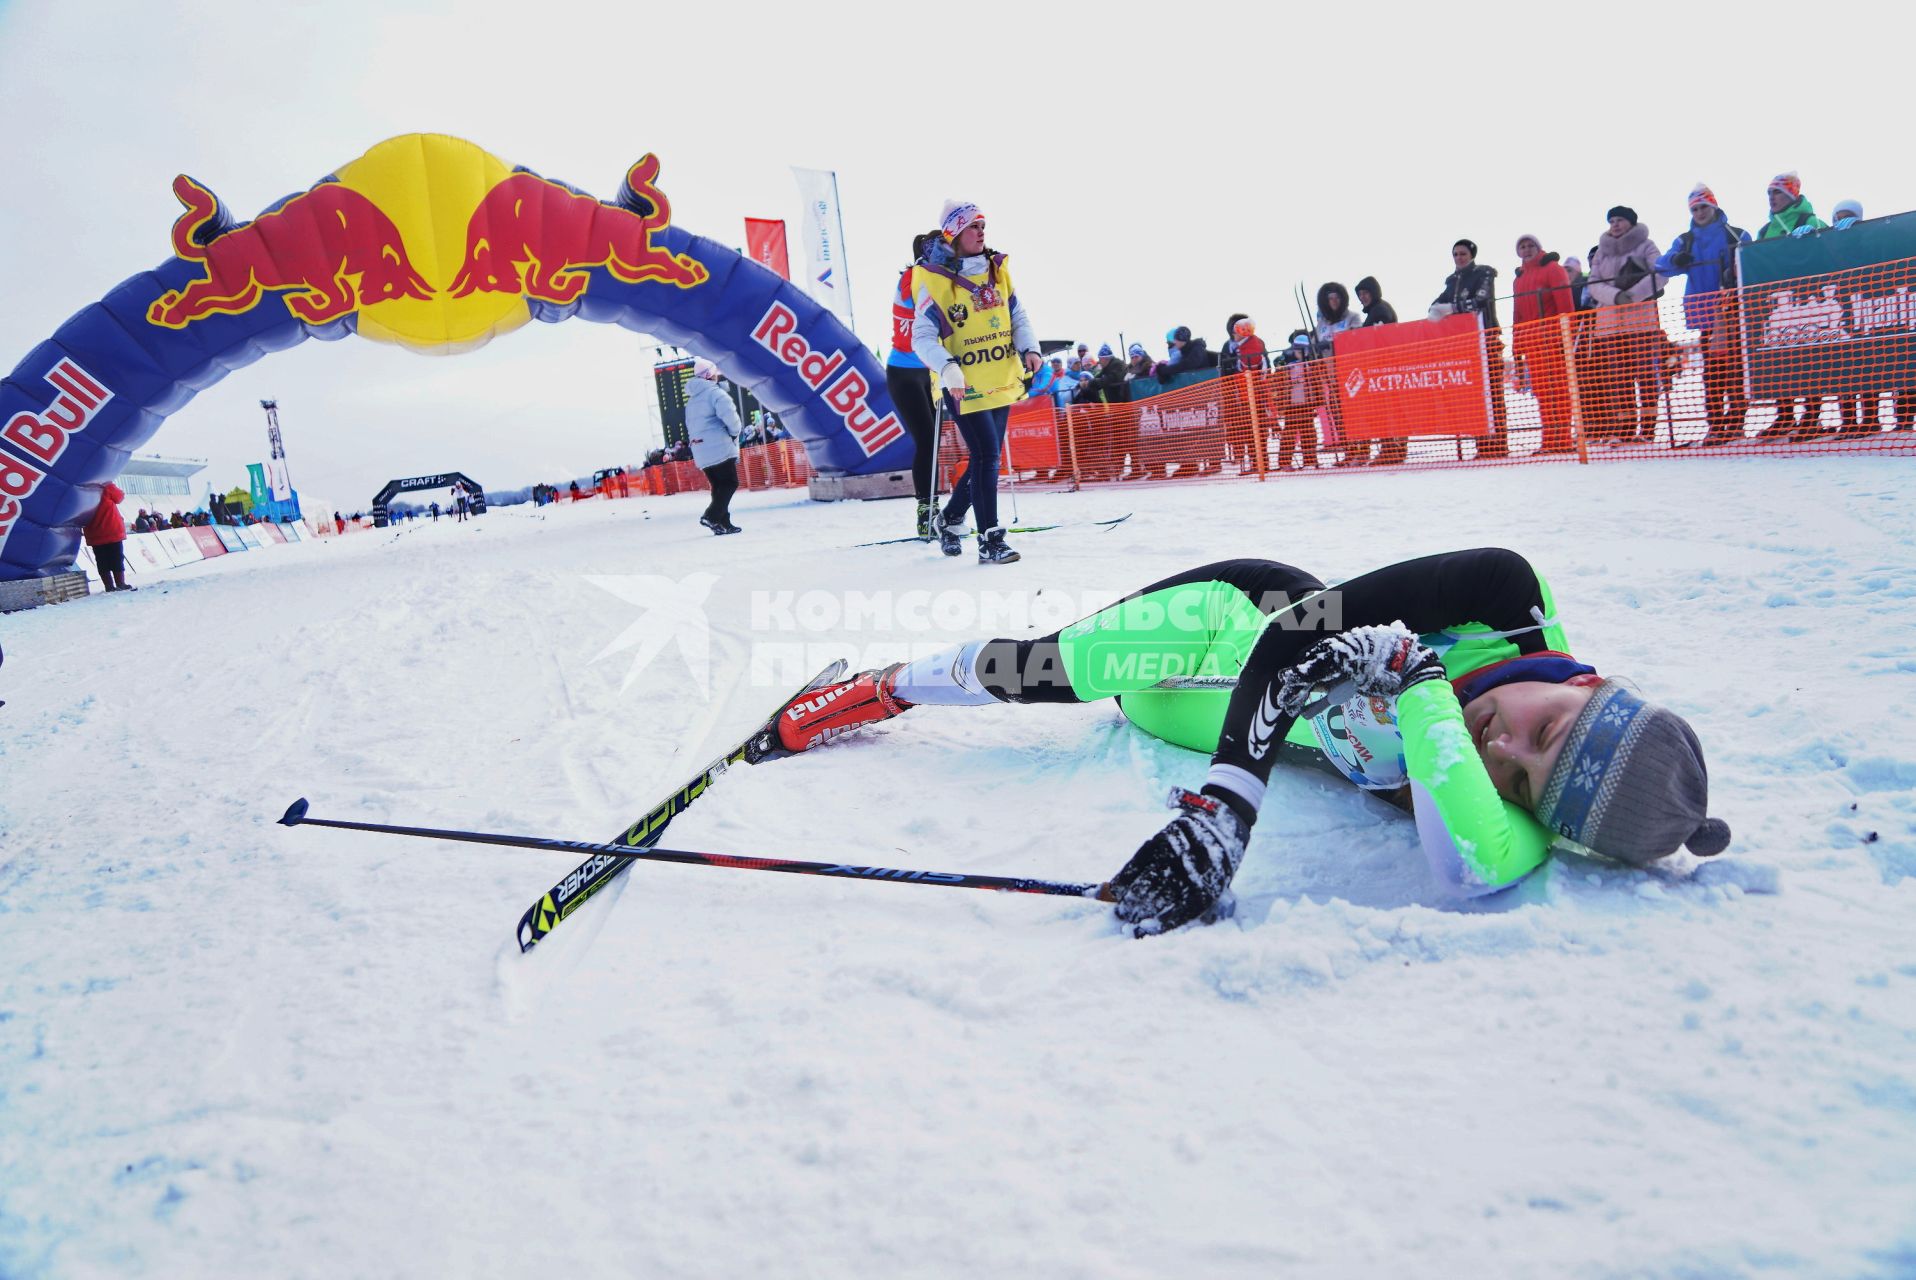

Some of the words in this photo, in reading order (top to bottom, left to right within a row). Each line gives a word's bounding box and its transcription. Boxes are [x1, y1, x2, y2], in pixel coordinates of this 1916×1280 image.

[963, 332, 997, 346] ЛЫЖНЯ
[754, 303, 844, 388] Red
[825, 370, 902, 455] Bull
[1367, 369, 1473, 393] АСТРАМЕД-МС
[3, 361, 109, 463] Bull
[400, 477, 437, 488] CRAFT
